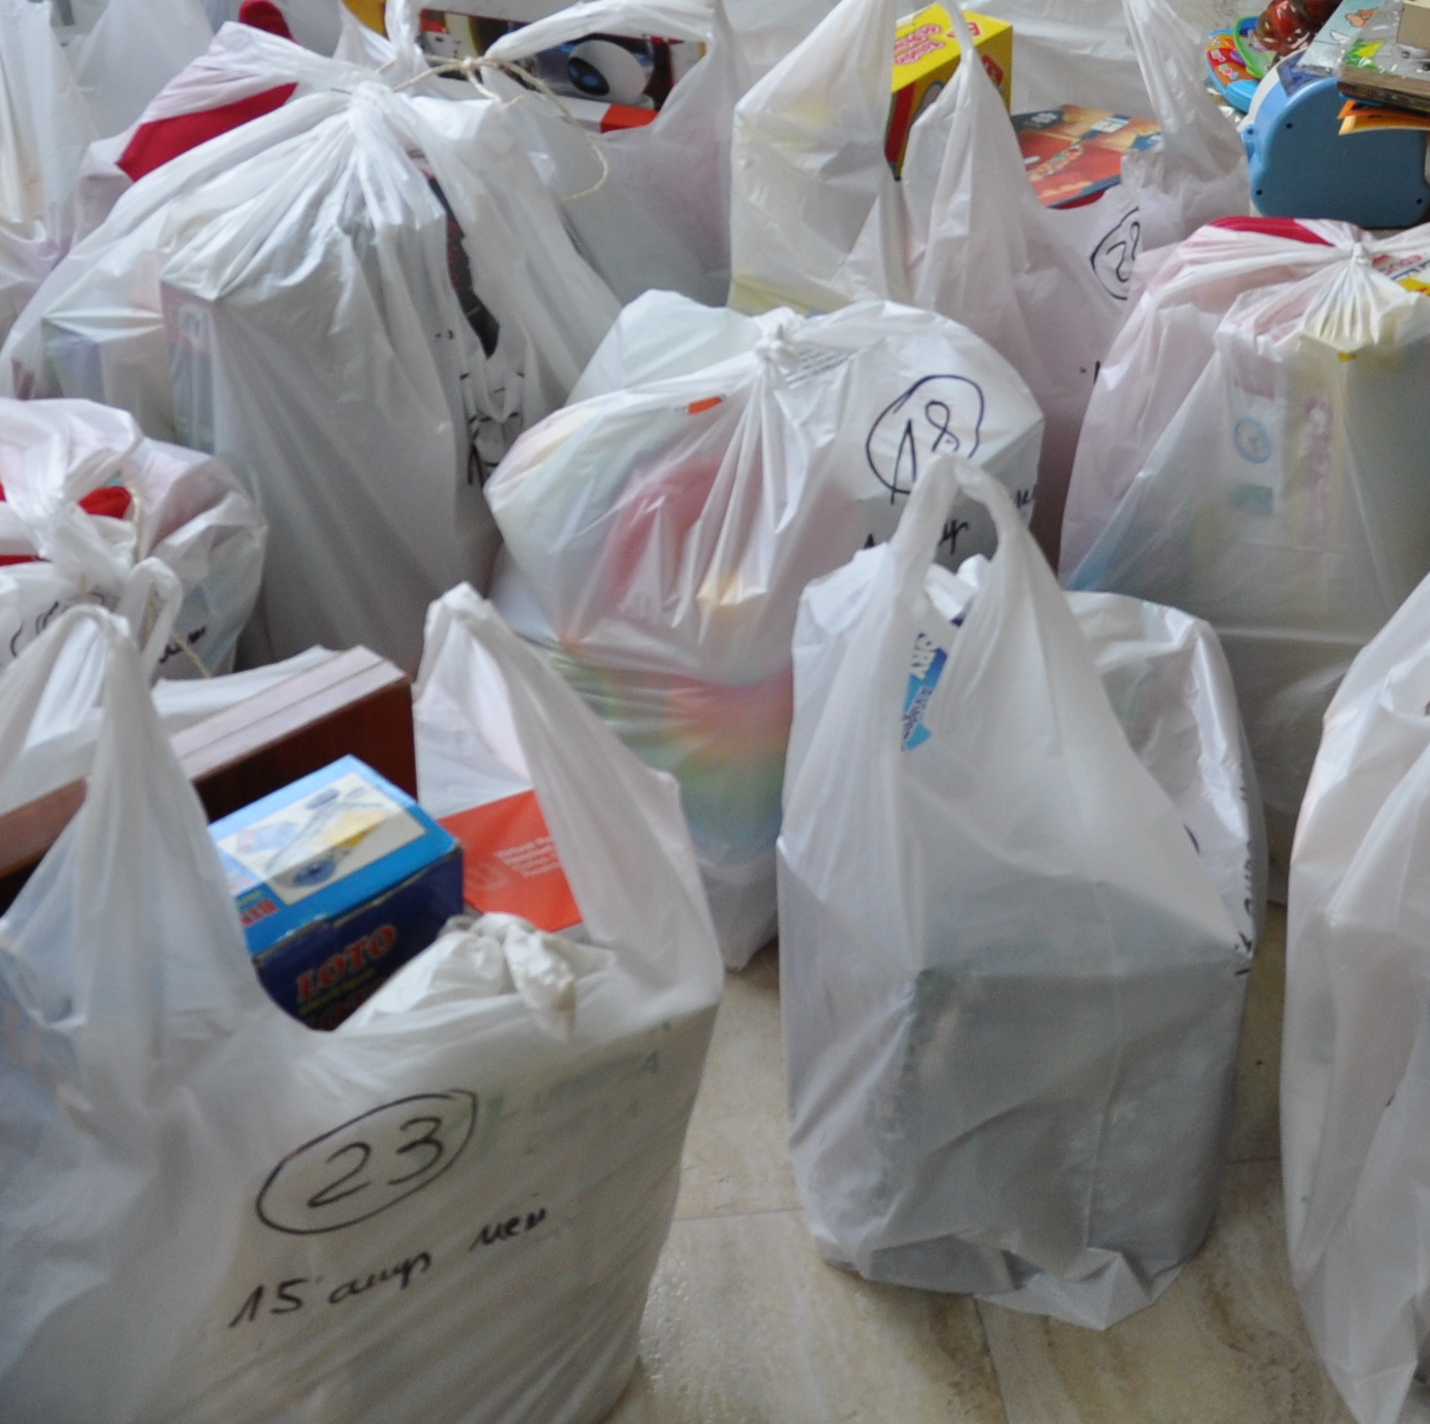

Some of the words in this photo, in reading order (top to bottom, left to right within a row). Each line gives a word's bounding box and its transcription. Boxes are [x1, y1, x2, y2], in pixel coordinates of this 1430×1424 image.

[296, 924, 397, 1006] LOTO
[307, 1116, 446, 1211] 23
[228, 1278, 306, 1331] 15
